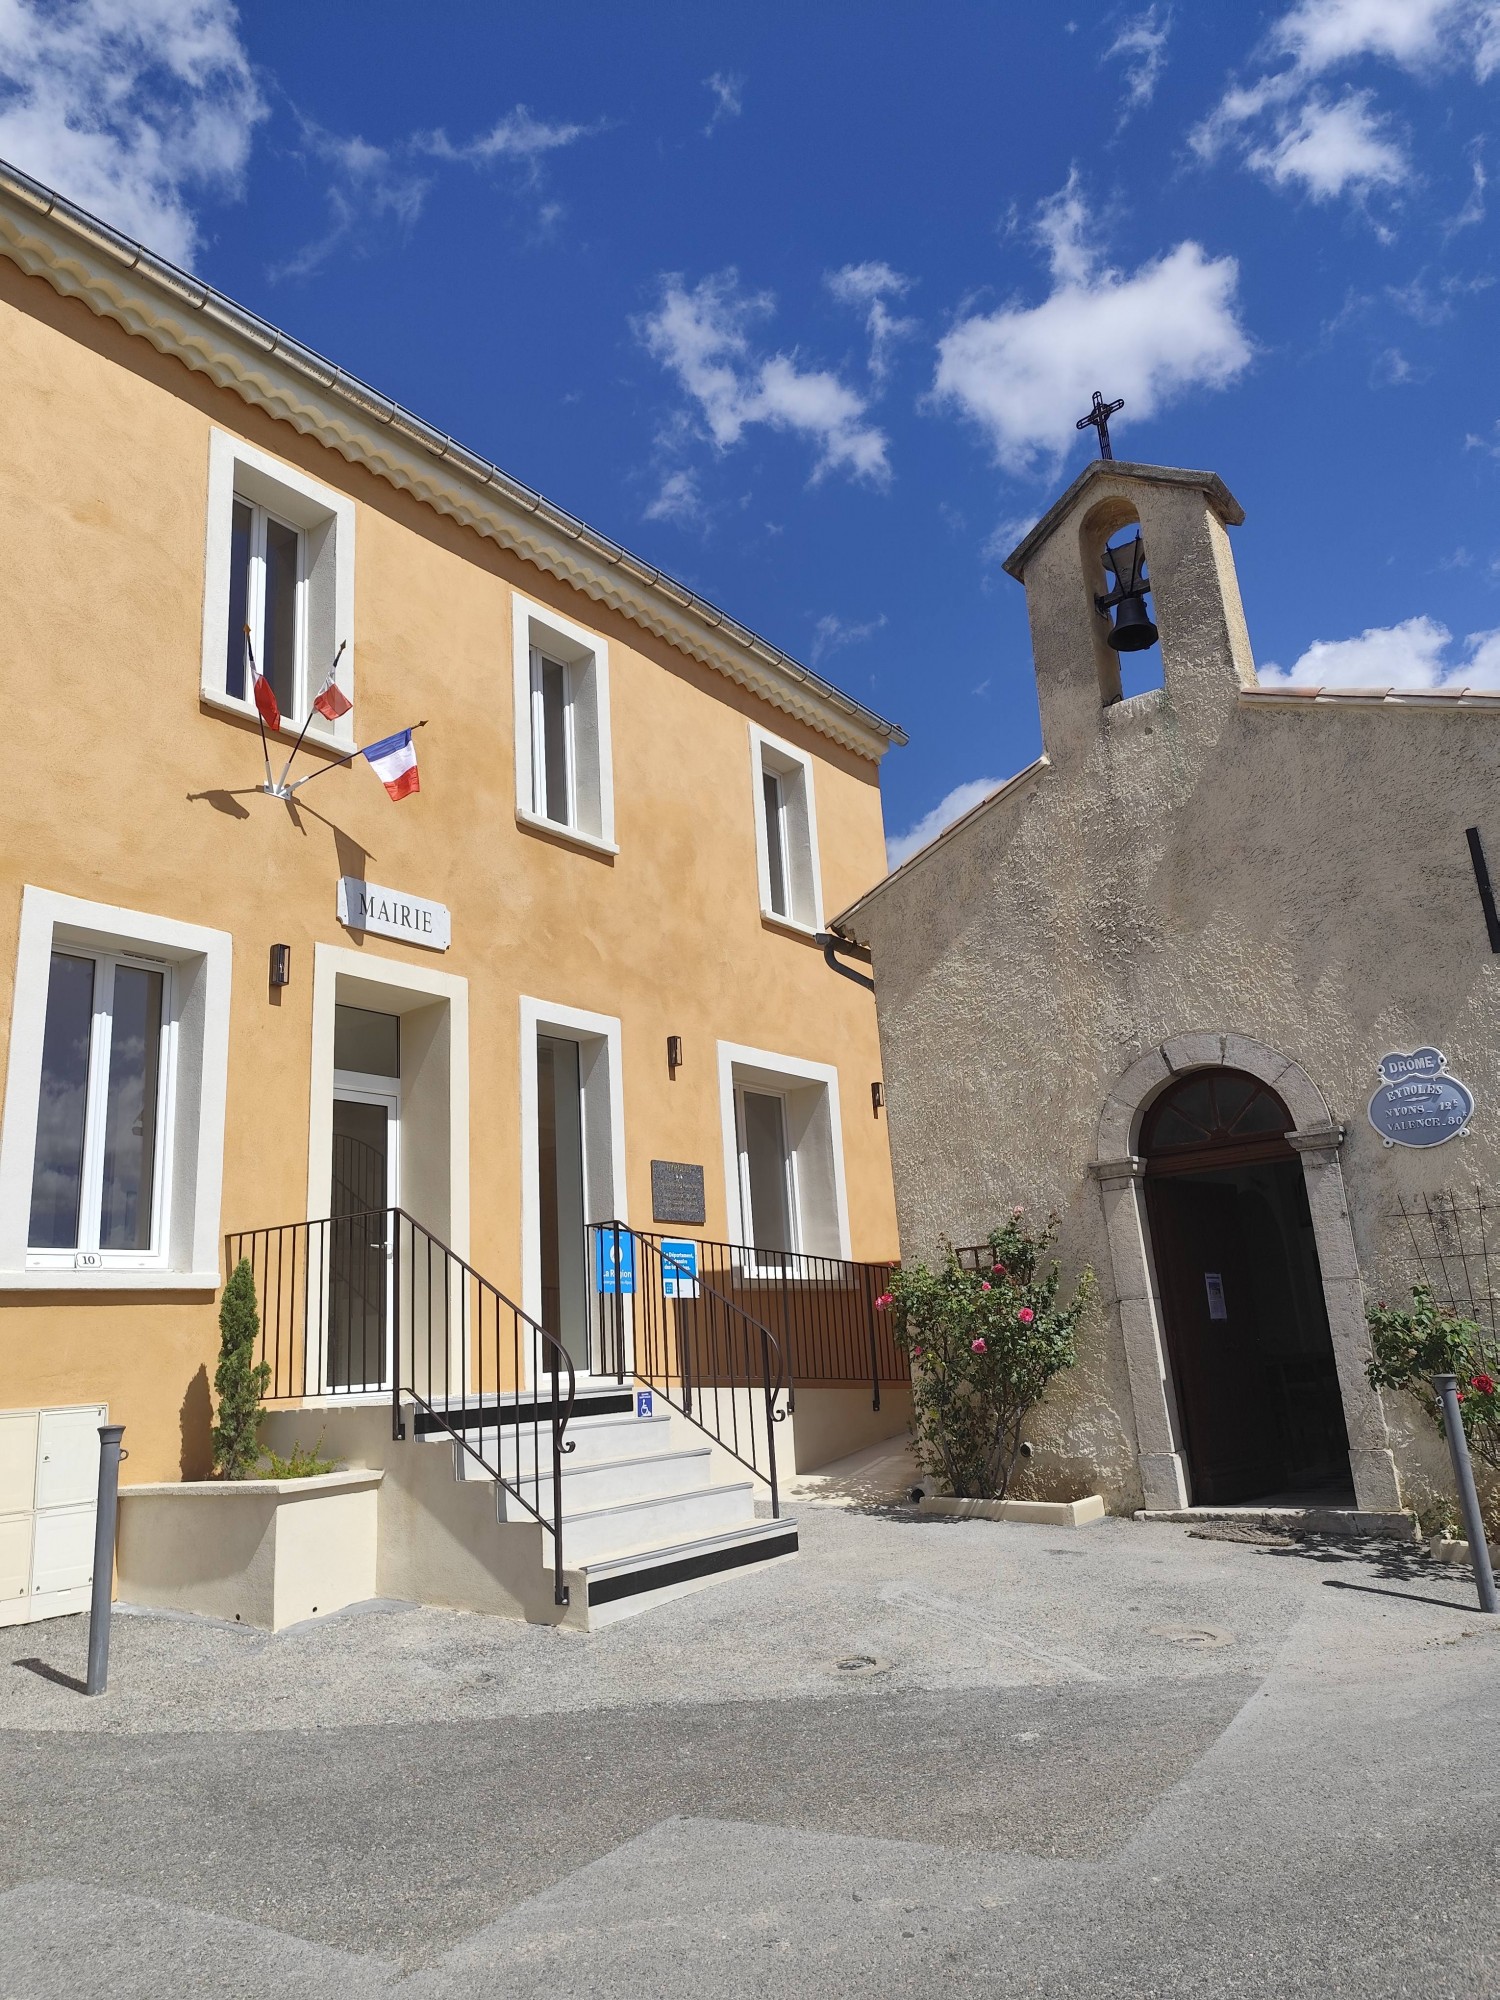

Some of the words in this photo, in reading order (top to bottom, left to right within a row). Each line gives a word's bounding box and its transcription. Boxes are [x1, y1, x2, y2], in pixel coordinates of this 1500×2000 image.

[359, 892, 433, 934] MAIRIE
[1388, 1056, 1435, 1074] DRÔME
[1385, 1104, 1425, 1118] NYONS
[1386, 1117, 1441, 1132] VALENCE
[82, 1255, 95, 1265] 10
